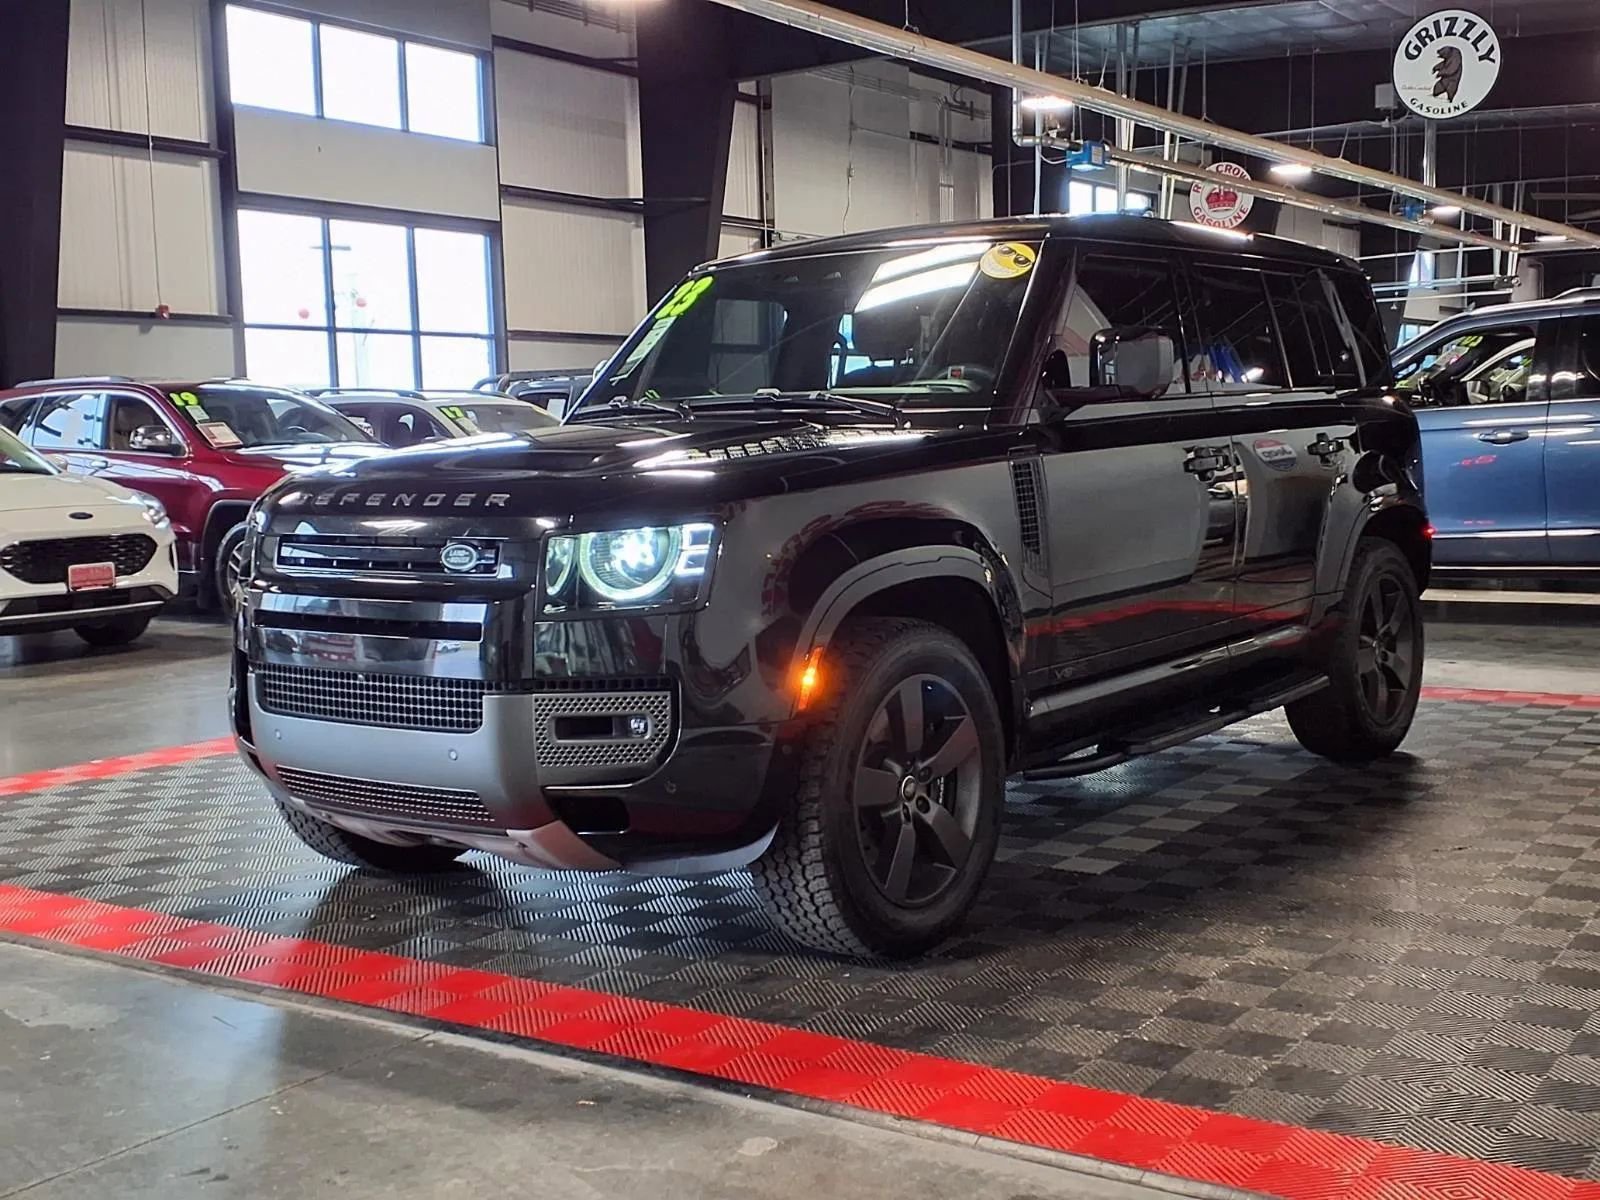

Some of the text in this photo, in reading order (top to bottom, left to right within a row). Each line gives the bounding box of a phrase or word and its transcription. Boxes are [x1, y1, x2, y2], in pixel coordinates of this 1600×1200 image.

[1405, 16, 1496, 64] GRIZZLY
[1410, 98, 1468, 115] GASOLINE
[1216, 164, 1249, 180] CROW
[1194, 206, 1249, 229] GASOLINE
[169, 392, 198, 406] 19
[440, 406, 464, 418] 17
[288, 493, 511, 507] DEFENDER
